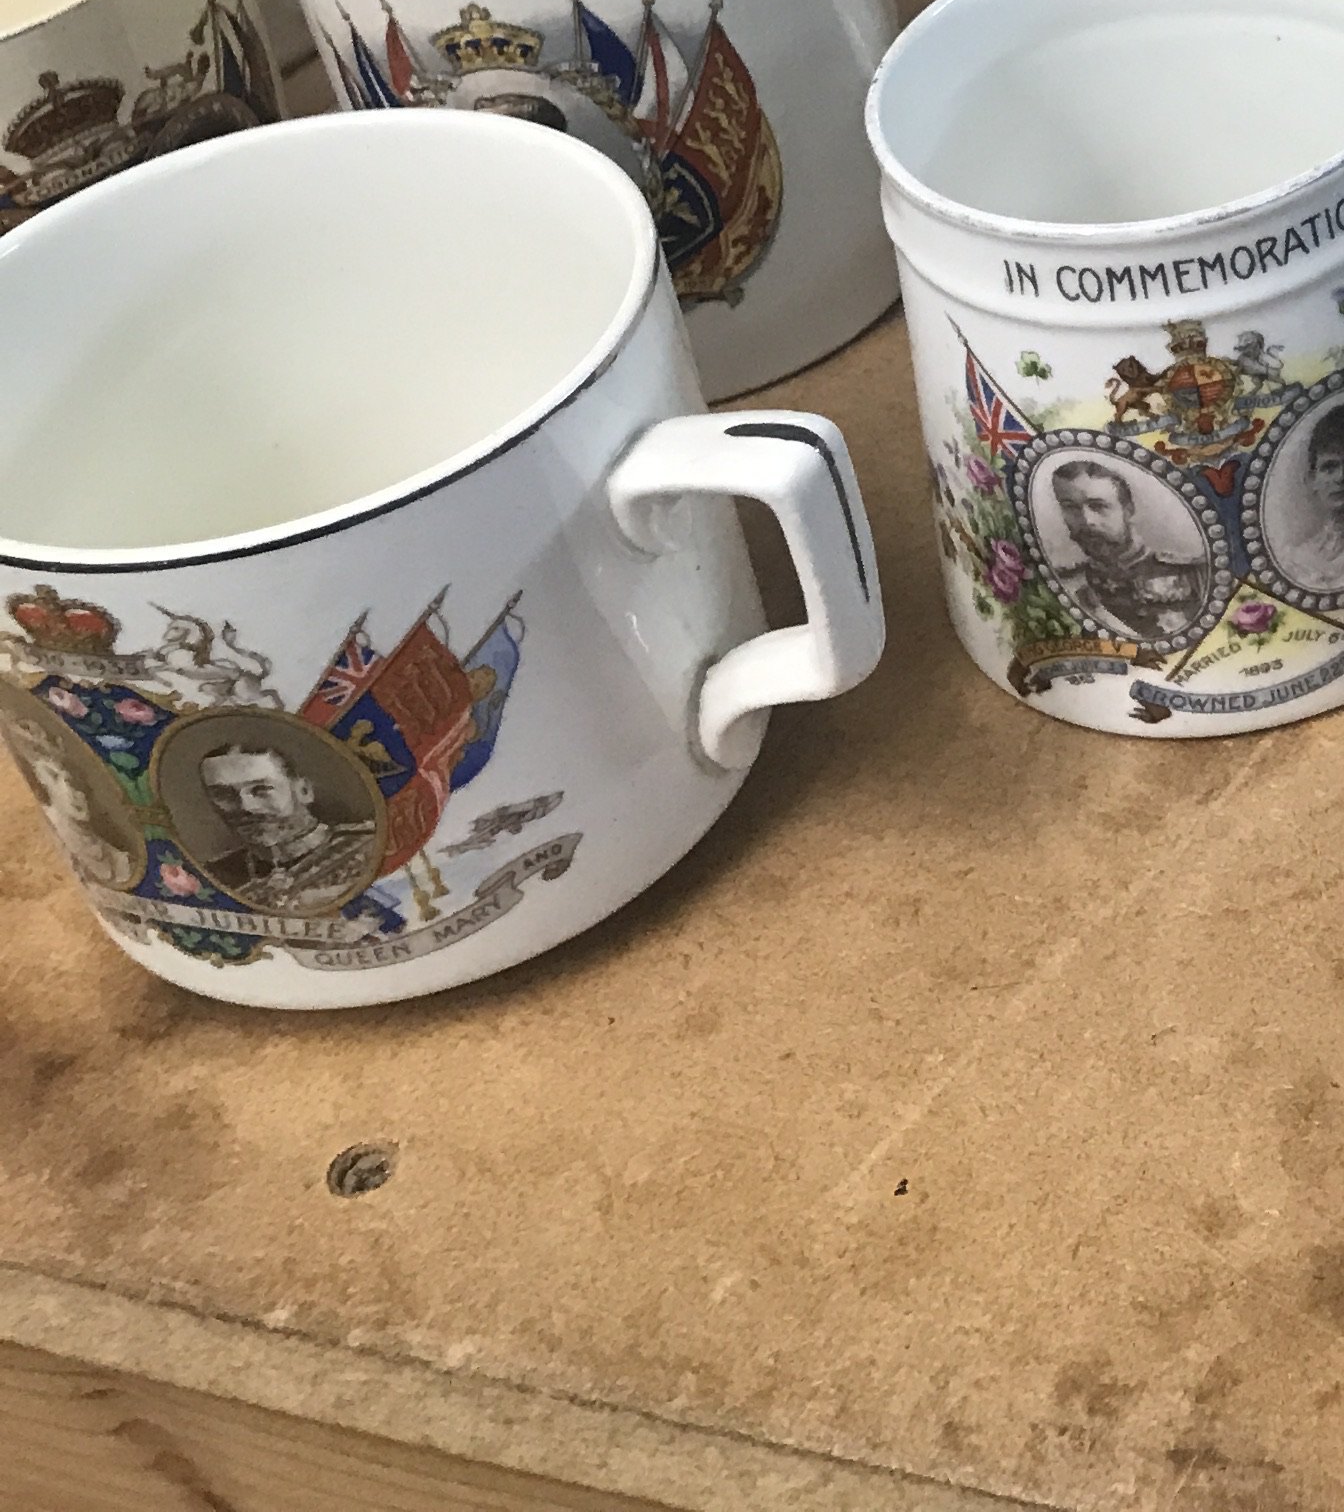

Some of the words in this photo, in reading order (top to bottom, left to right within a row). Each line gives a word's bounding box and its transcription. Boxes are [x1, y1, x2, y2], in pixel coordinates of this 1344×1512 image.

[1003, 259, 1040, 298] IN
[1174, 641, 1243, 687] MARRIED
[1283, 629, 1326, 643] JULY
[1137, 685, 1257, 712] CROWNED
[1263, 675, 1316, 706] JUNE
[523, 844, 563, 870] AND
[195, 907, 346, 940] JUBILEE
[314, 942, 412, 966] QUEEN
[432, 894, 502, 943] MARY
